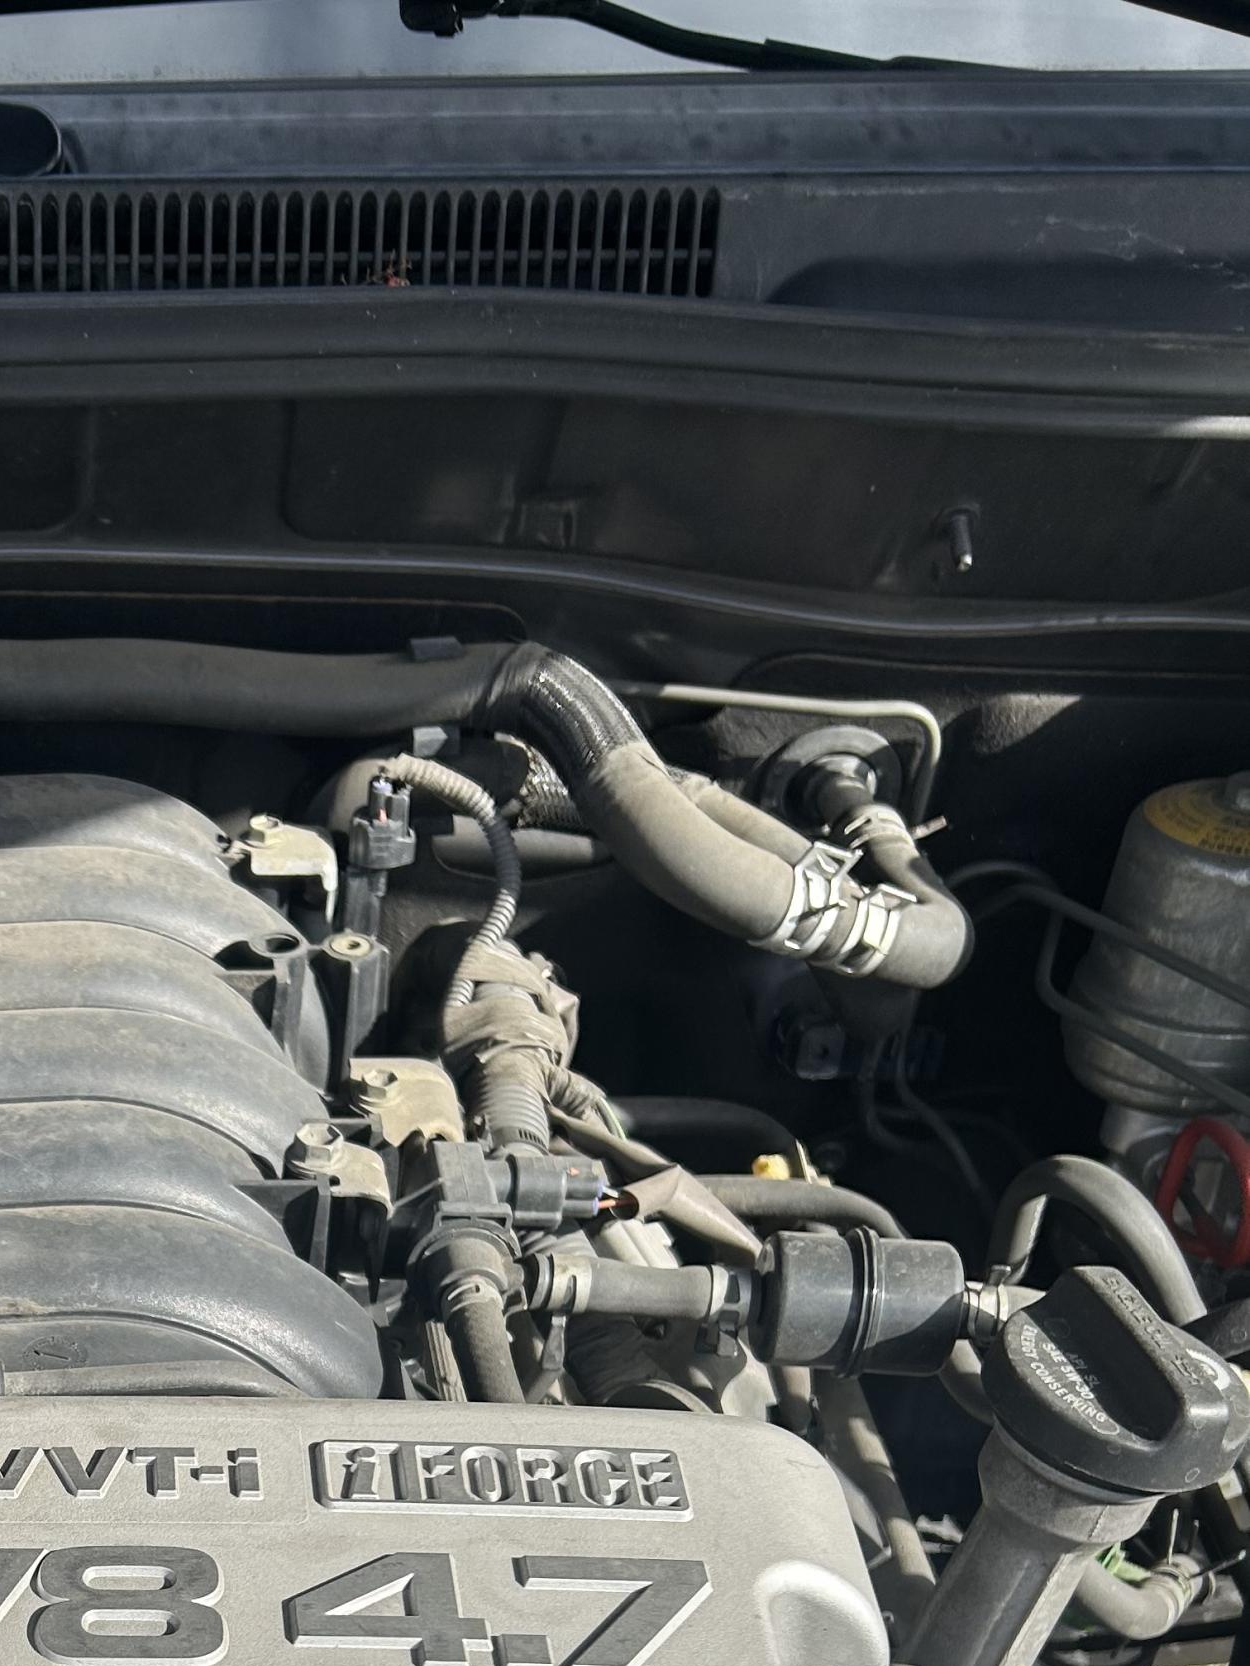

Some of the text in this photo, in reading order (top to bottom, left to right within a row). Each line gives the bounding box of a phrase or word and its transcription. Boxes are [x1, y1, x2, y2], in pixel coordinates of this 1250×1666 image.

[1020, 1323, 1108, 1423] ENERGY CONSERVING
[1042, 1342, 1094, 1402] SAE 5W-30
